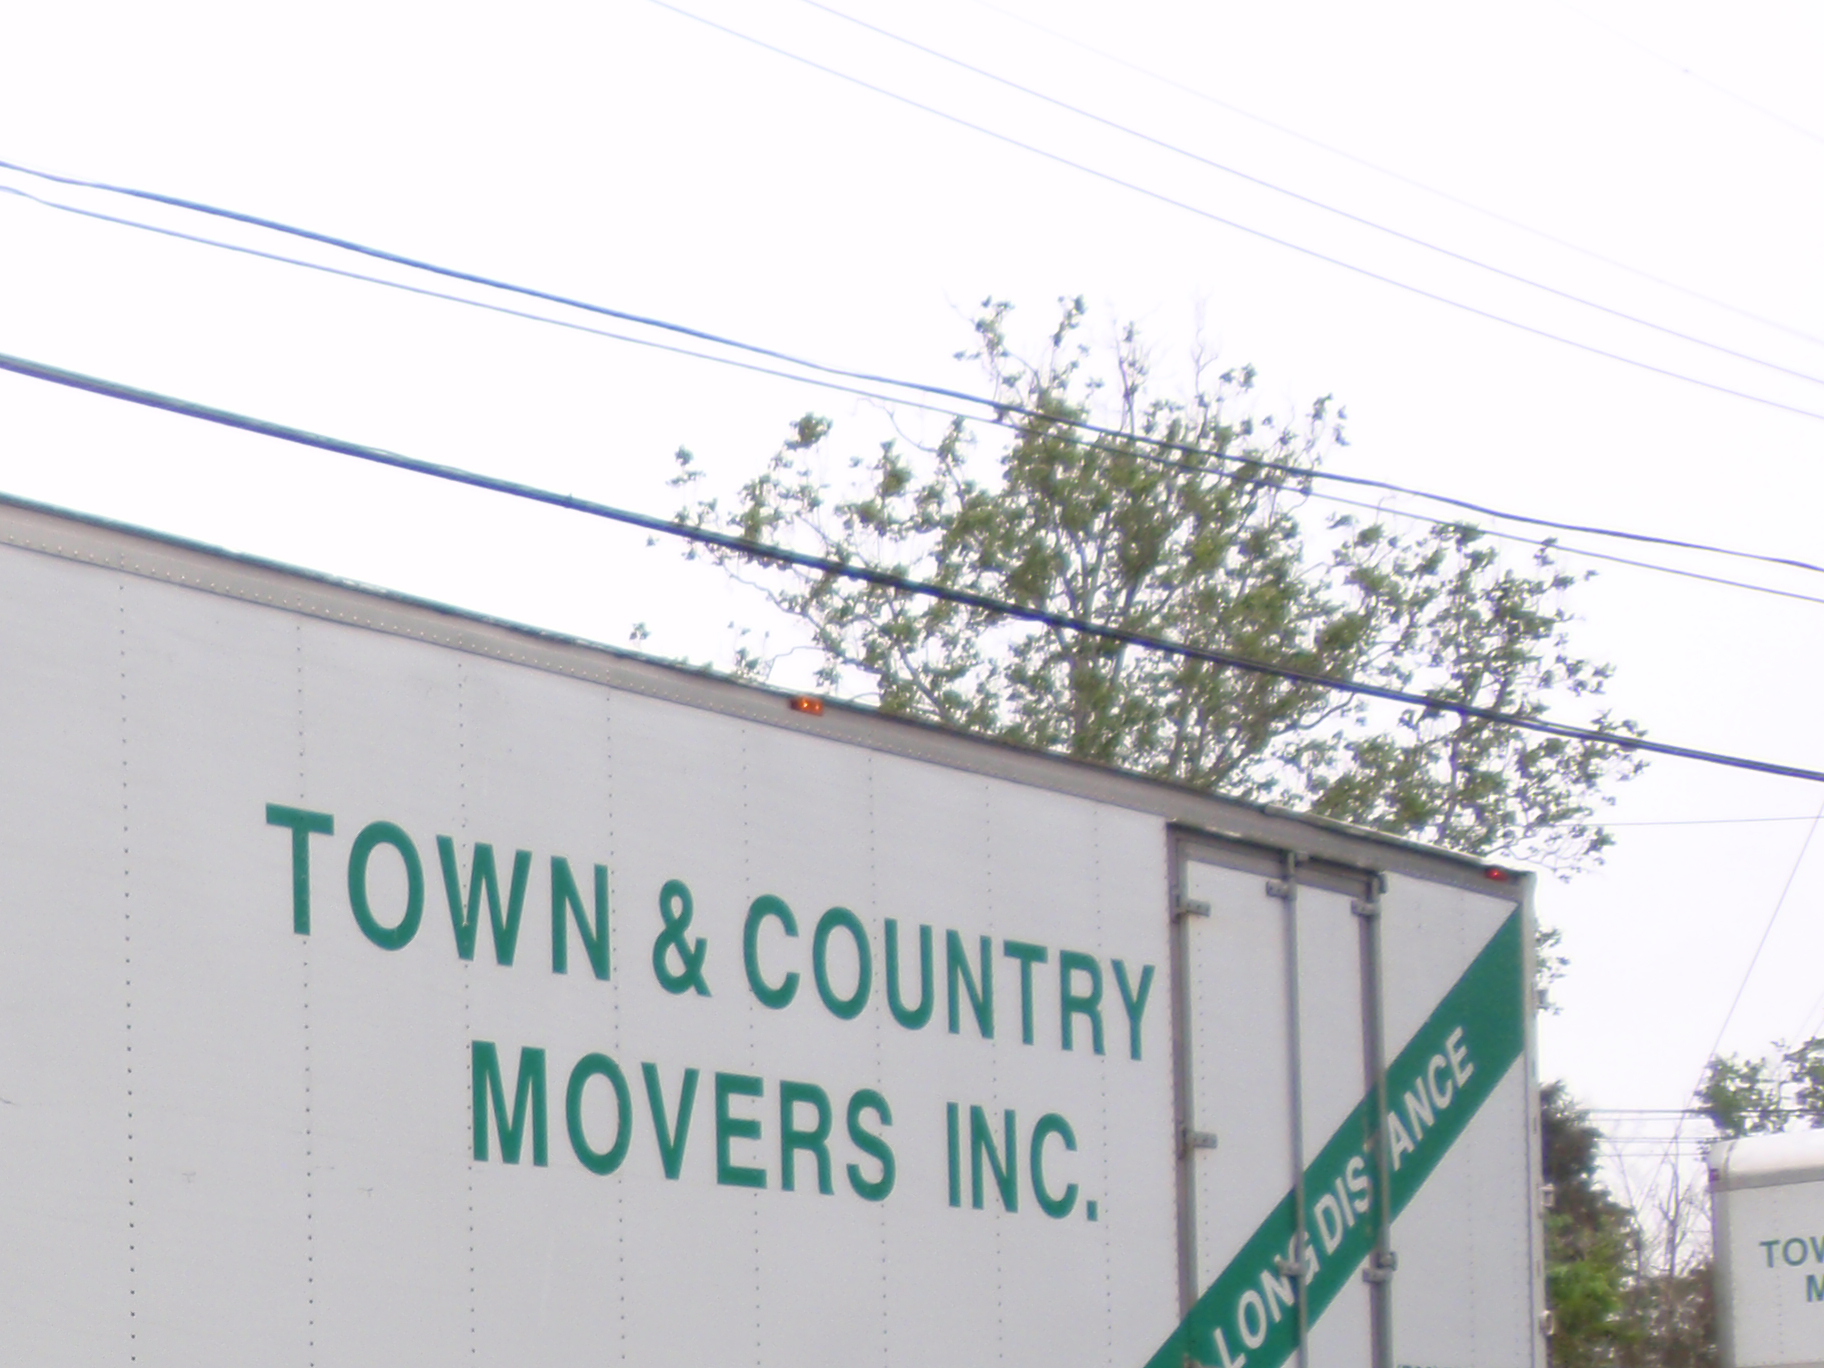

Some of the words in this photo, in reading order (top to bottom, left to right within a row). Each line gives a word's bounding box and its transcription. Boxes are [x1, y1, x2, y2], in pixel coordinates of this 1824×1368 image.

[266, 803, 611, 982] TOWN
[652, 879, 712, 997] &
[743, 894, 1155, 1061] COUNTRY
[471, 1040, 897, 1202] MOVERS
[946, 1101, 1098, 1222] INC.
[1314, 1026, 1474, 1255] DISANCE
